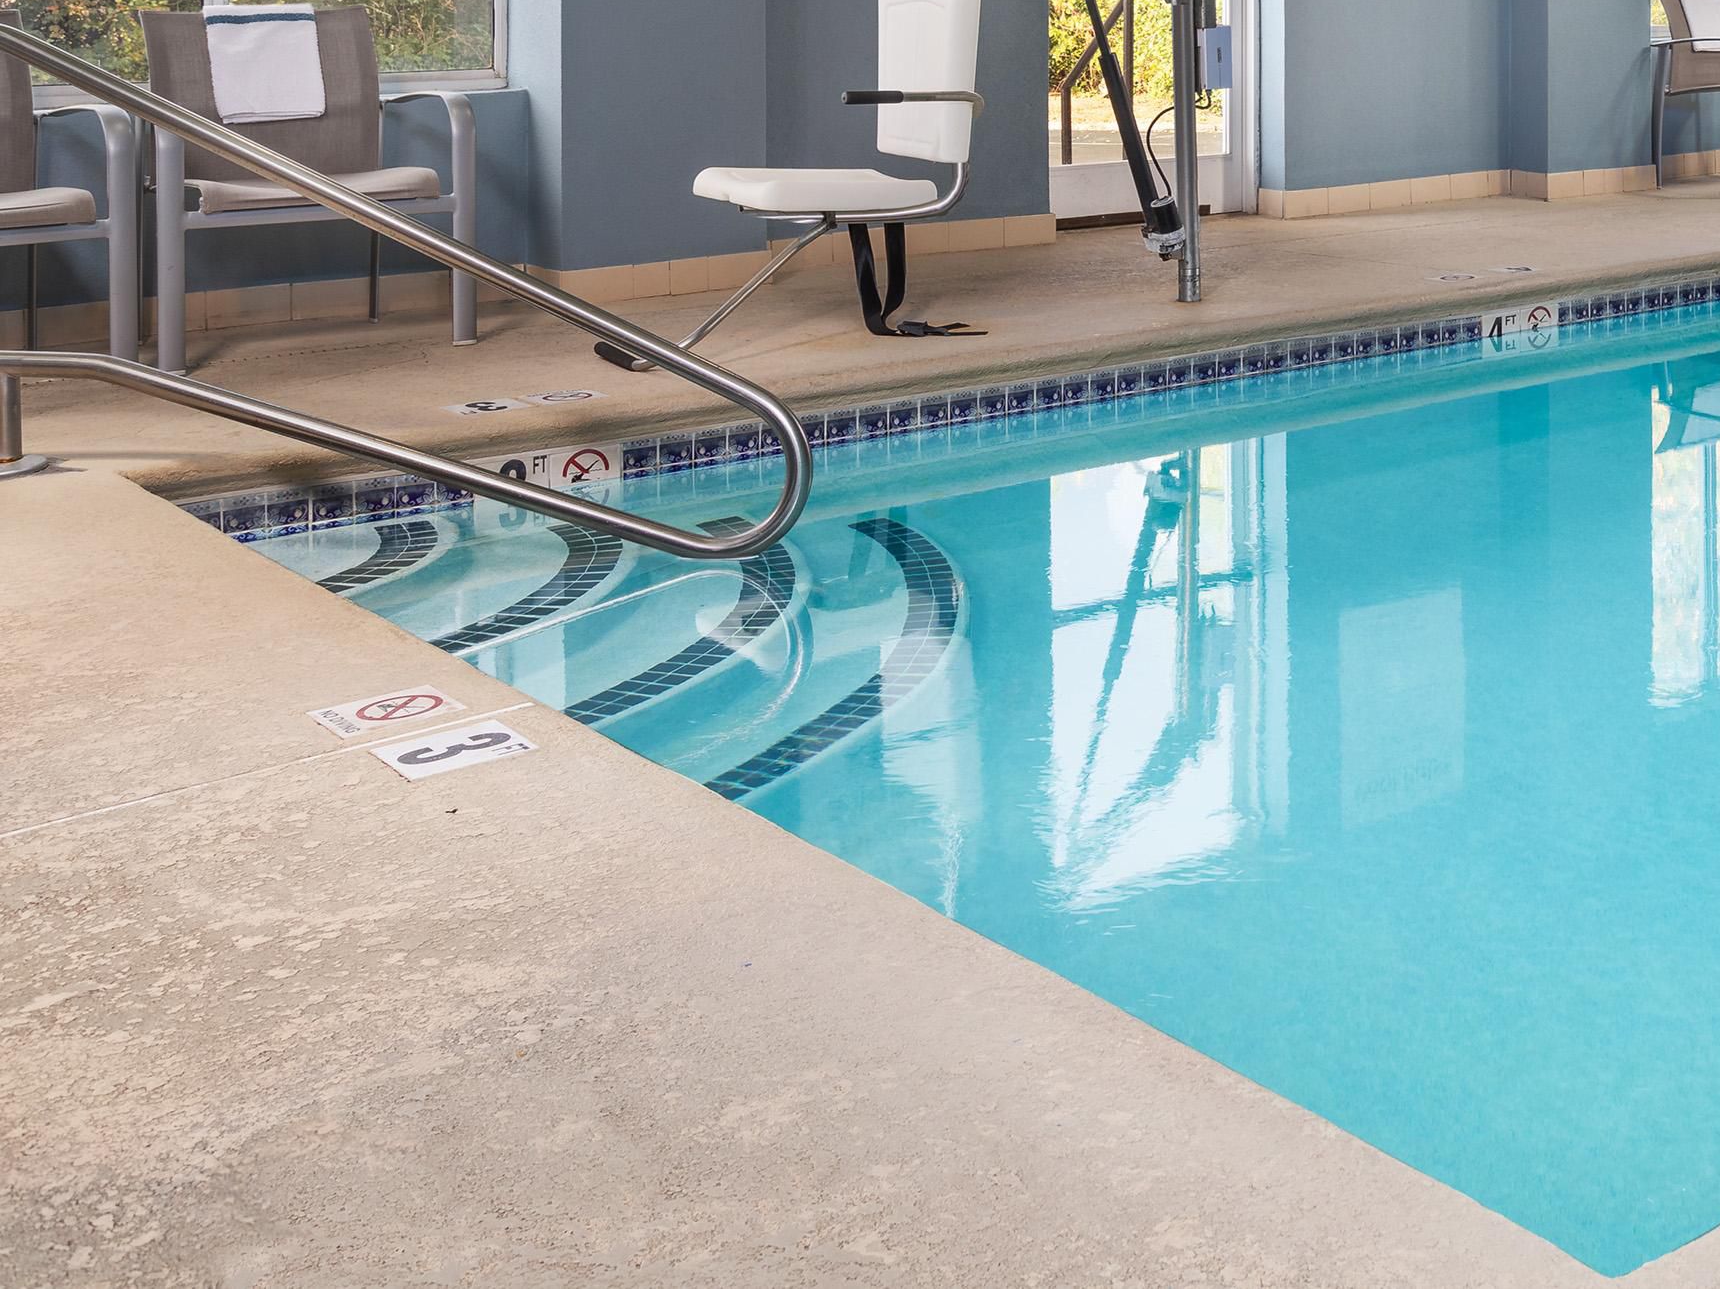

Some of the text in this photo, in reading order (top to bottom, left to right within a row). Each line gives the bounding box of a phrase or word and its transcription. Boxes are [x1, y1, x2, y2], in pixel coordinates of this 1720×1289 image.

[1505, 314, 1517, 326] FT
[532, 455, 548, 474] FT
[328, 716, 361, 734] DIVING
[397, 732, 531, 765] 3 FT
